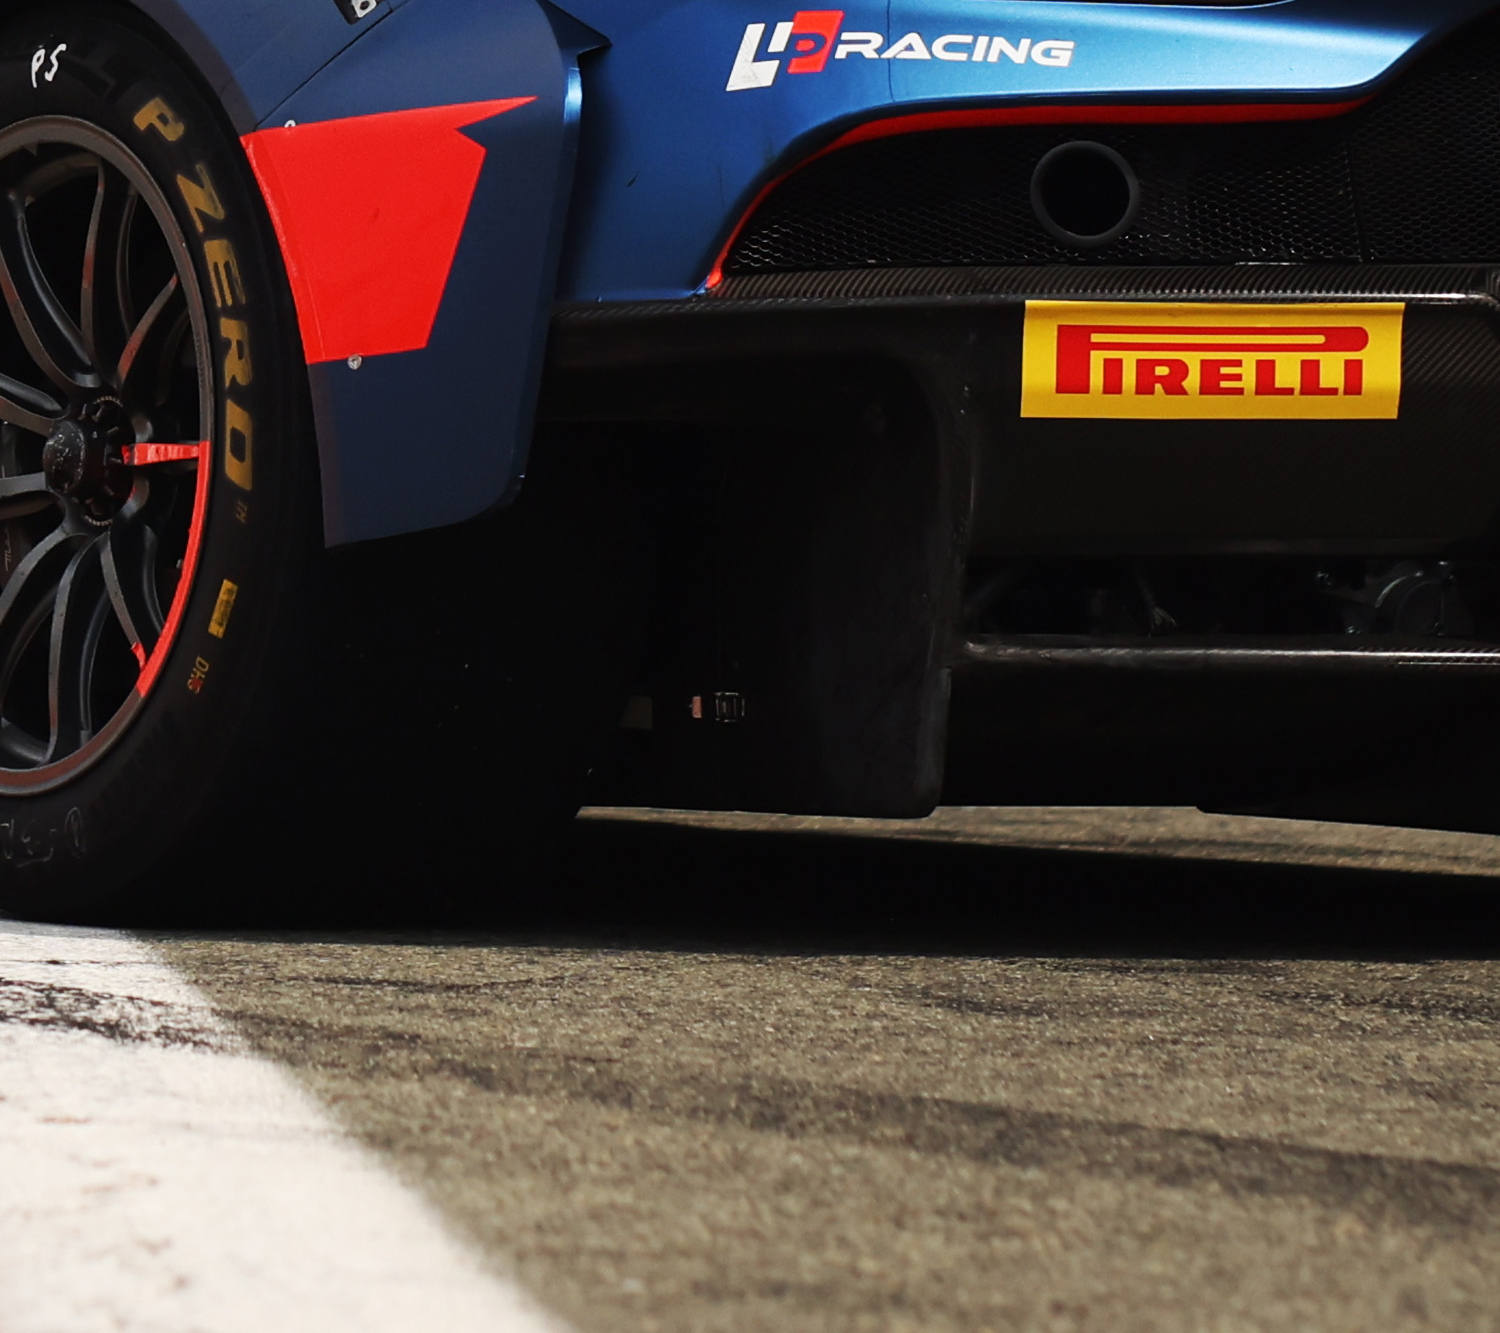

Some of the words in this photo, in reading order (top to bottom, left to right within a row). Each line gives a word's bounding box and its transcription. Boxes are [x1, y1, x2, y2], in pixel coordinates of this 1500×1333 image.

[835, 31, 1075, 68] RACING
[175, 172, 256, 491] ZERO
[1056, 324, 1368, 396] PIRELLI
